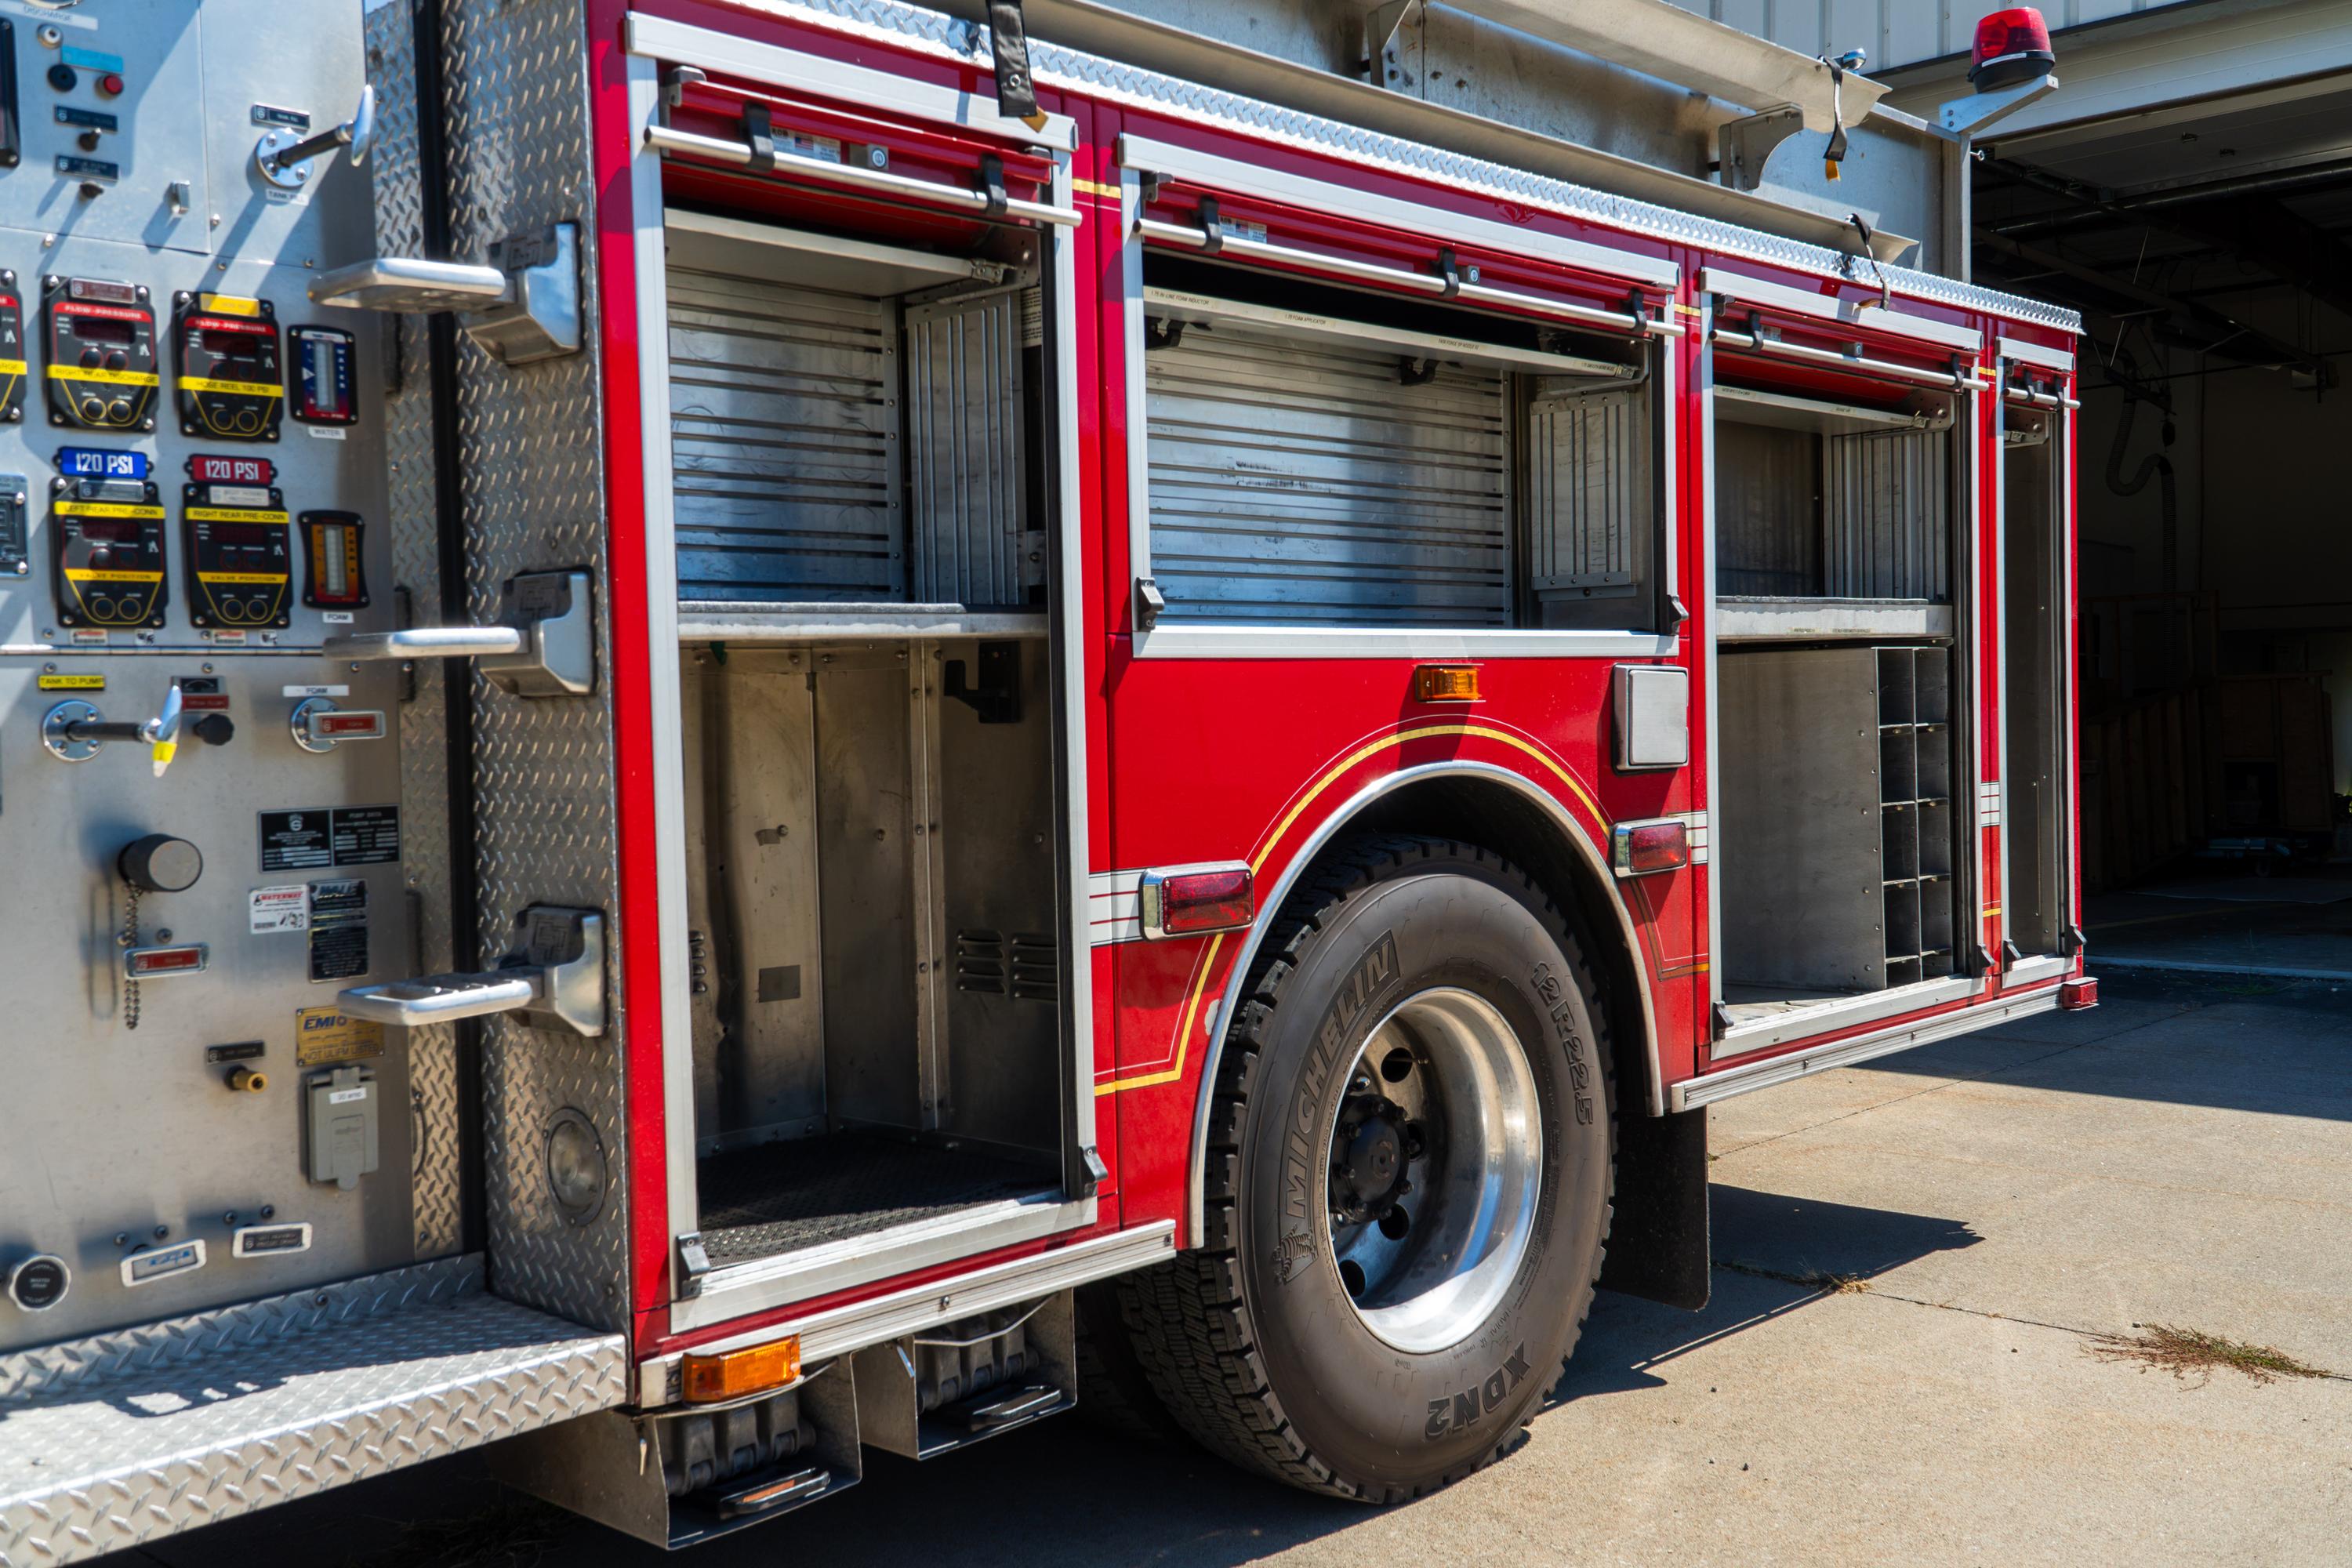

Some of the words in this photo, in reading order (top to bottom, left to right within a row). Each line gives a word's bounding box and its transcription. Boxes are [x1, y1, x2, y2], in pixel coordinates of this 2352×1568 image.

[55, 365, 77, 376] RIGHT
[83, 368, 107, 379] REAR
[108, 370, 158, 383] DISCHARGE
[196, 380, 219, 389] HOSE
[76, 453, 103, 472] 120
[107, 455, 133, 474] PSI
[205, 459, 230, 479] 120
[234, 462, 259, 480] PSI
[64, 504, 85, 514] LEFT
[112, 507, 158, 517] PRE-CONN
[193, 510, 218, 518] RIGHT
[242, 512, 285, 521] PRE-CONN
[303, 1015, 336, 1031] EMI
[1285, 939, 1390, 1219] MICHELIN
[1425, 1338, 1530, 1440] XDN2
